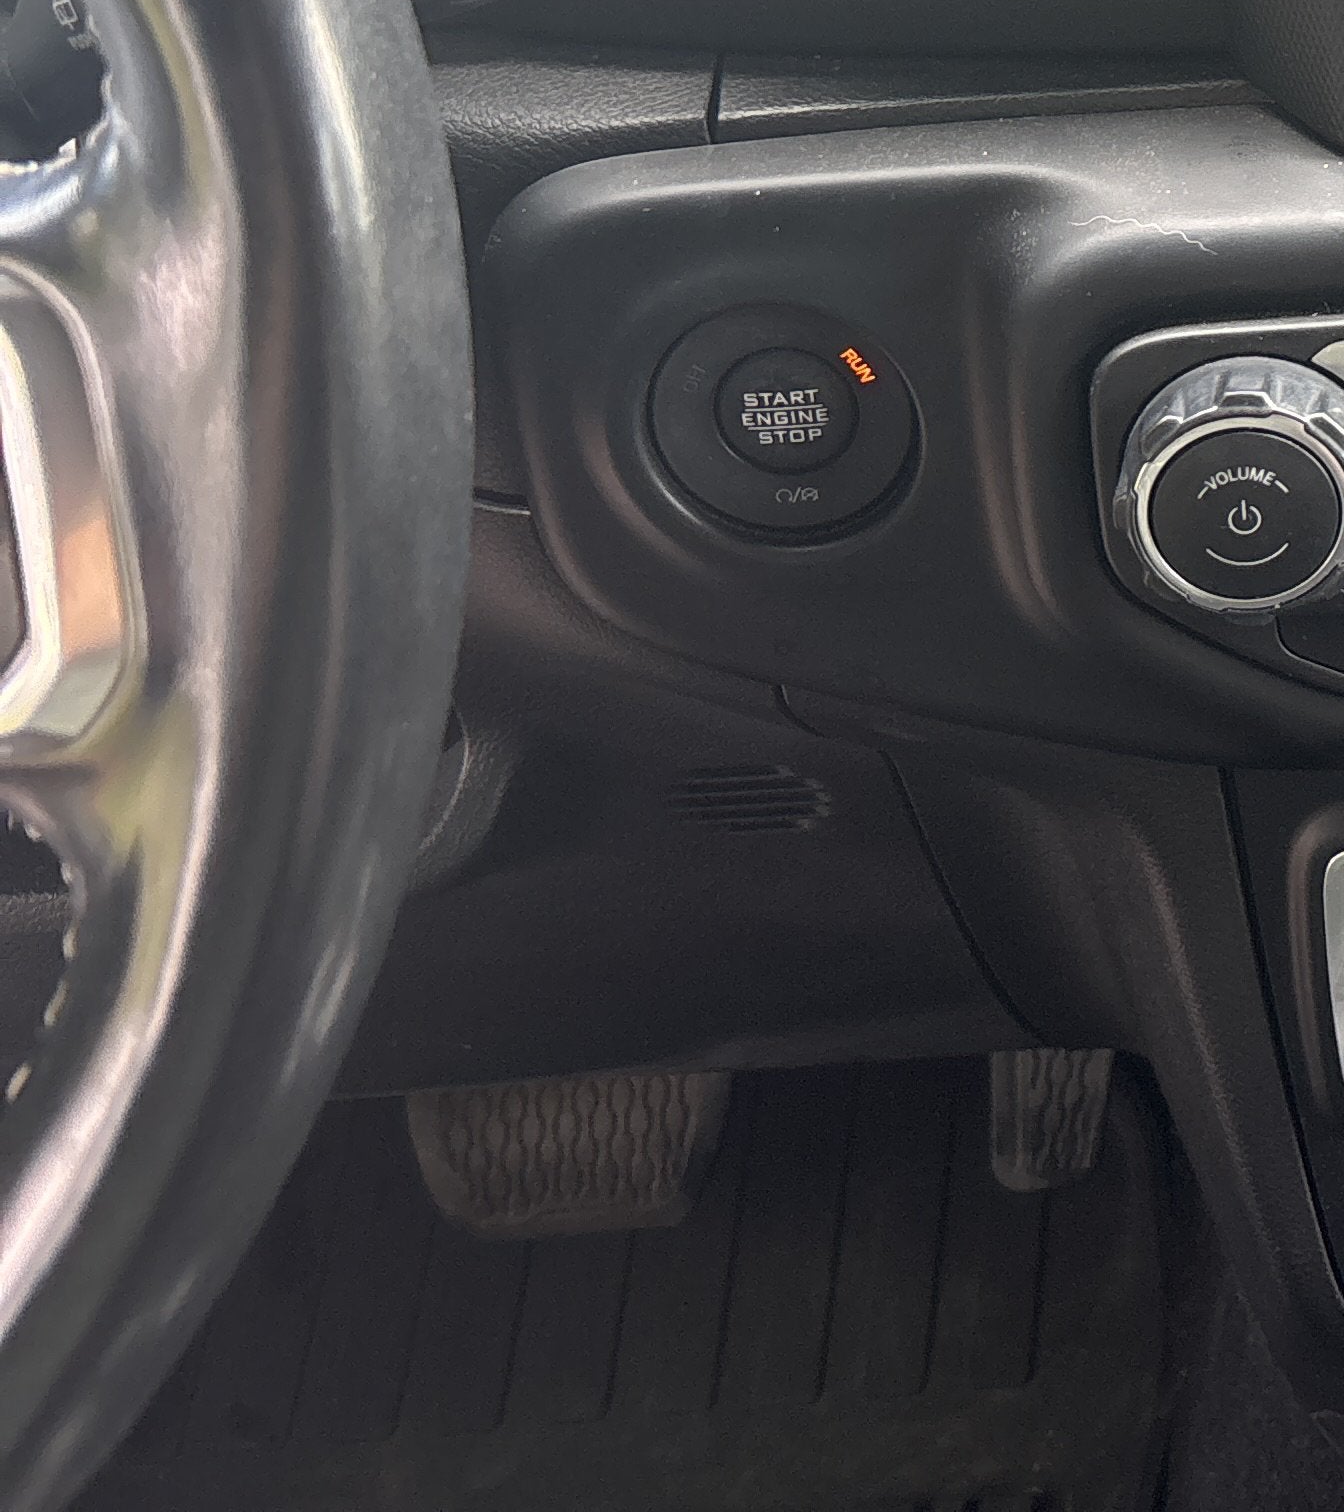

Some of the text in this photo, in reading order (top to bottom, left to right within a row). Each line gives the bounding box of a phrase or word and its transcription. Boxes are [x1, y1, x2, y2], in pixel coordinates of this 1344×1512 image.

[839, 347, 876, 384] RUN
[743, 388, 819, 407] START
[741, 407, 830, 427] ENGINE
[758, 428, 823, 445] STOP
[1206, 468, 1276, 489] VOLUME
